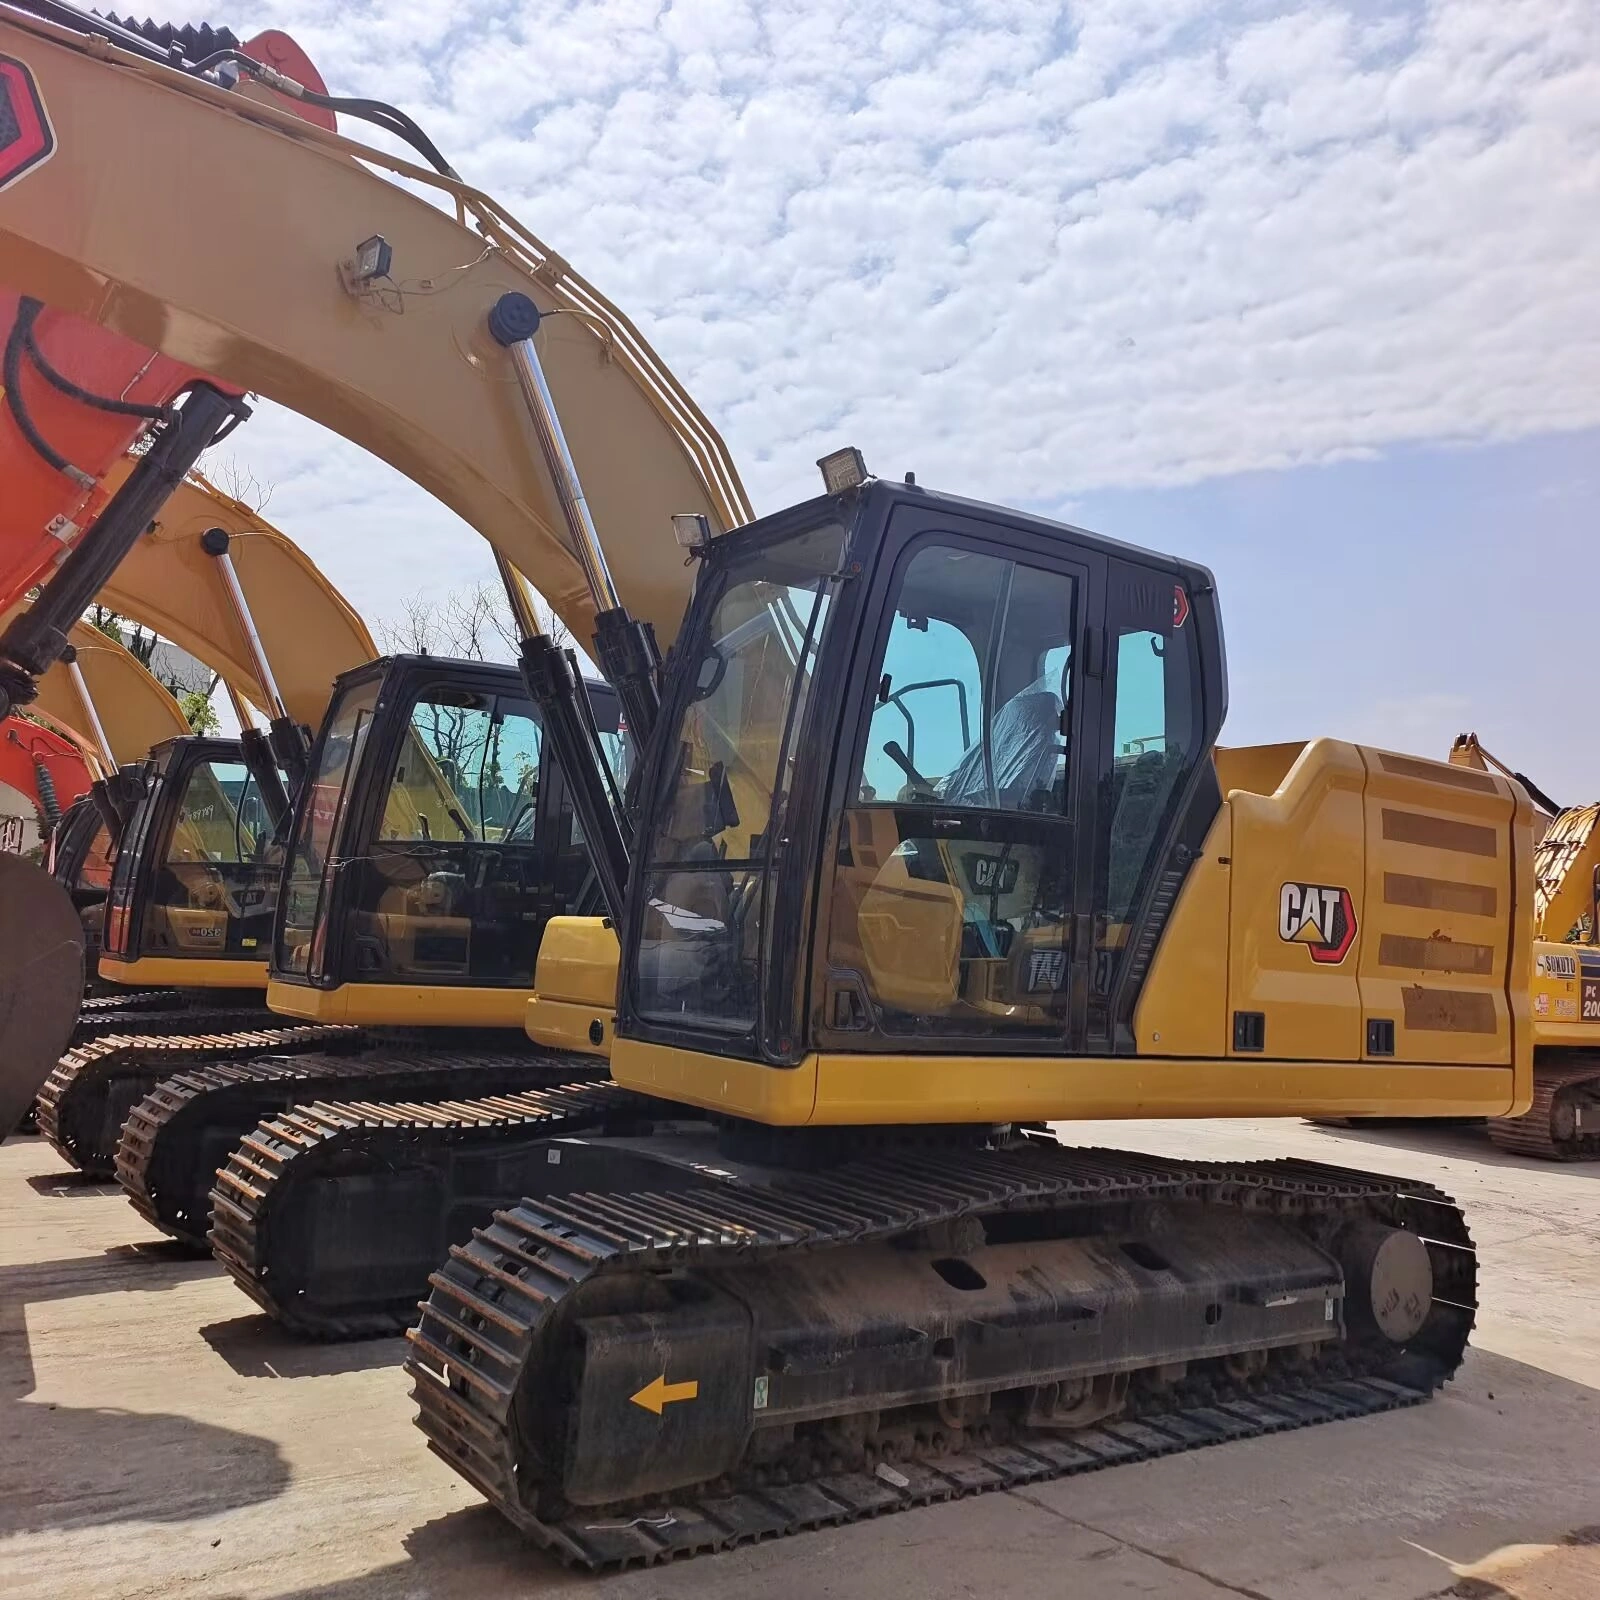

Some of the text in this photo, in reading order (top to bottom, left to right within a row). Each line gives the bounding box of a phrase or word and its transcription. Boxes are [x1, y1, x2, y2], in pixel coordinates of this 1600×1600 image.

[1280, 883, 1340, 944] CAT
[1545, 956, 1576, 973] SOKUTO
[1585, 985, 1597, 998] PC
